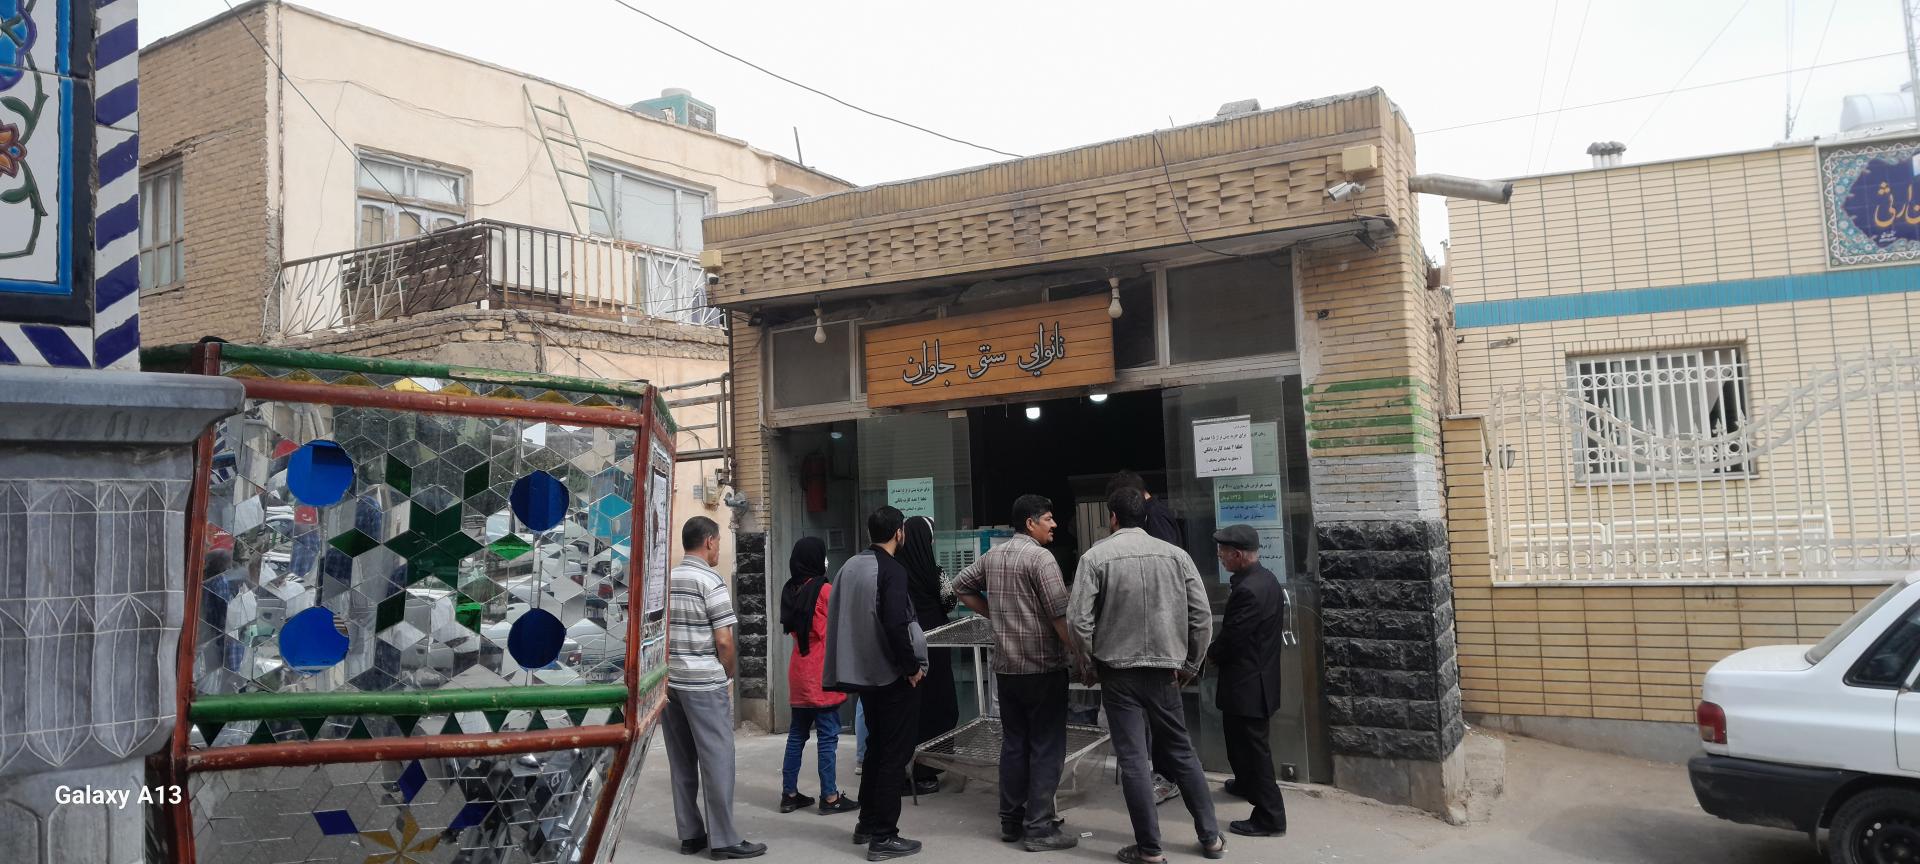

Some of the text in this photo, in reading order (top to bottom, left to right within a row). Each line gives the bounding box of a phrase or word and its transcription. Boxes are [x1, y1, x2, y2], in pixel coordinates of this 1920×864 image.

[902, 321, 1066, 387] نانوایی سنتی جاوان
